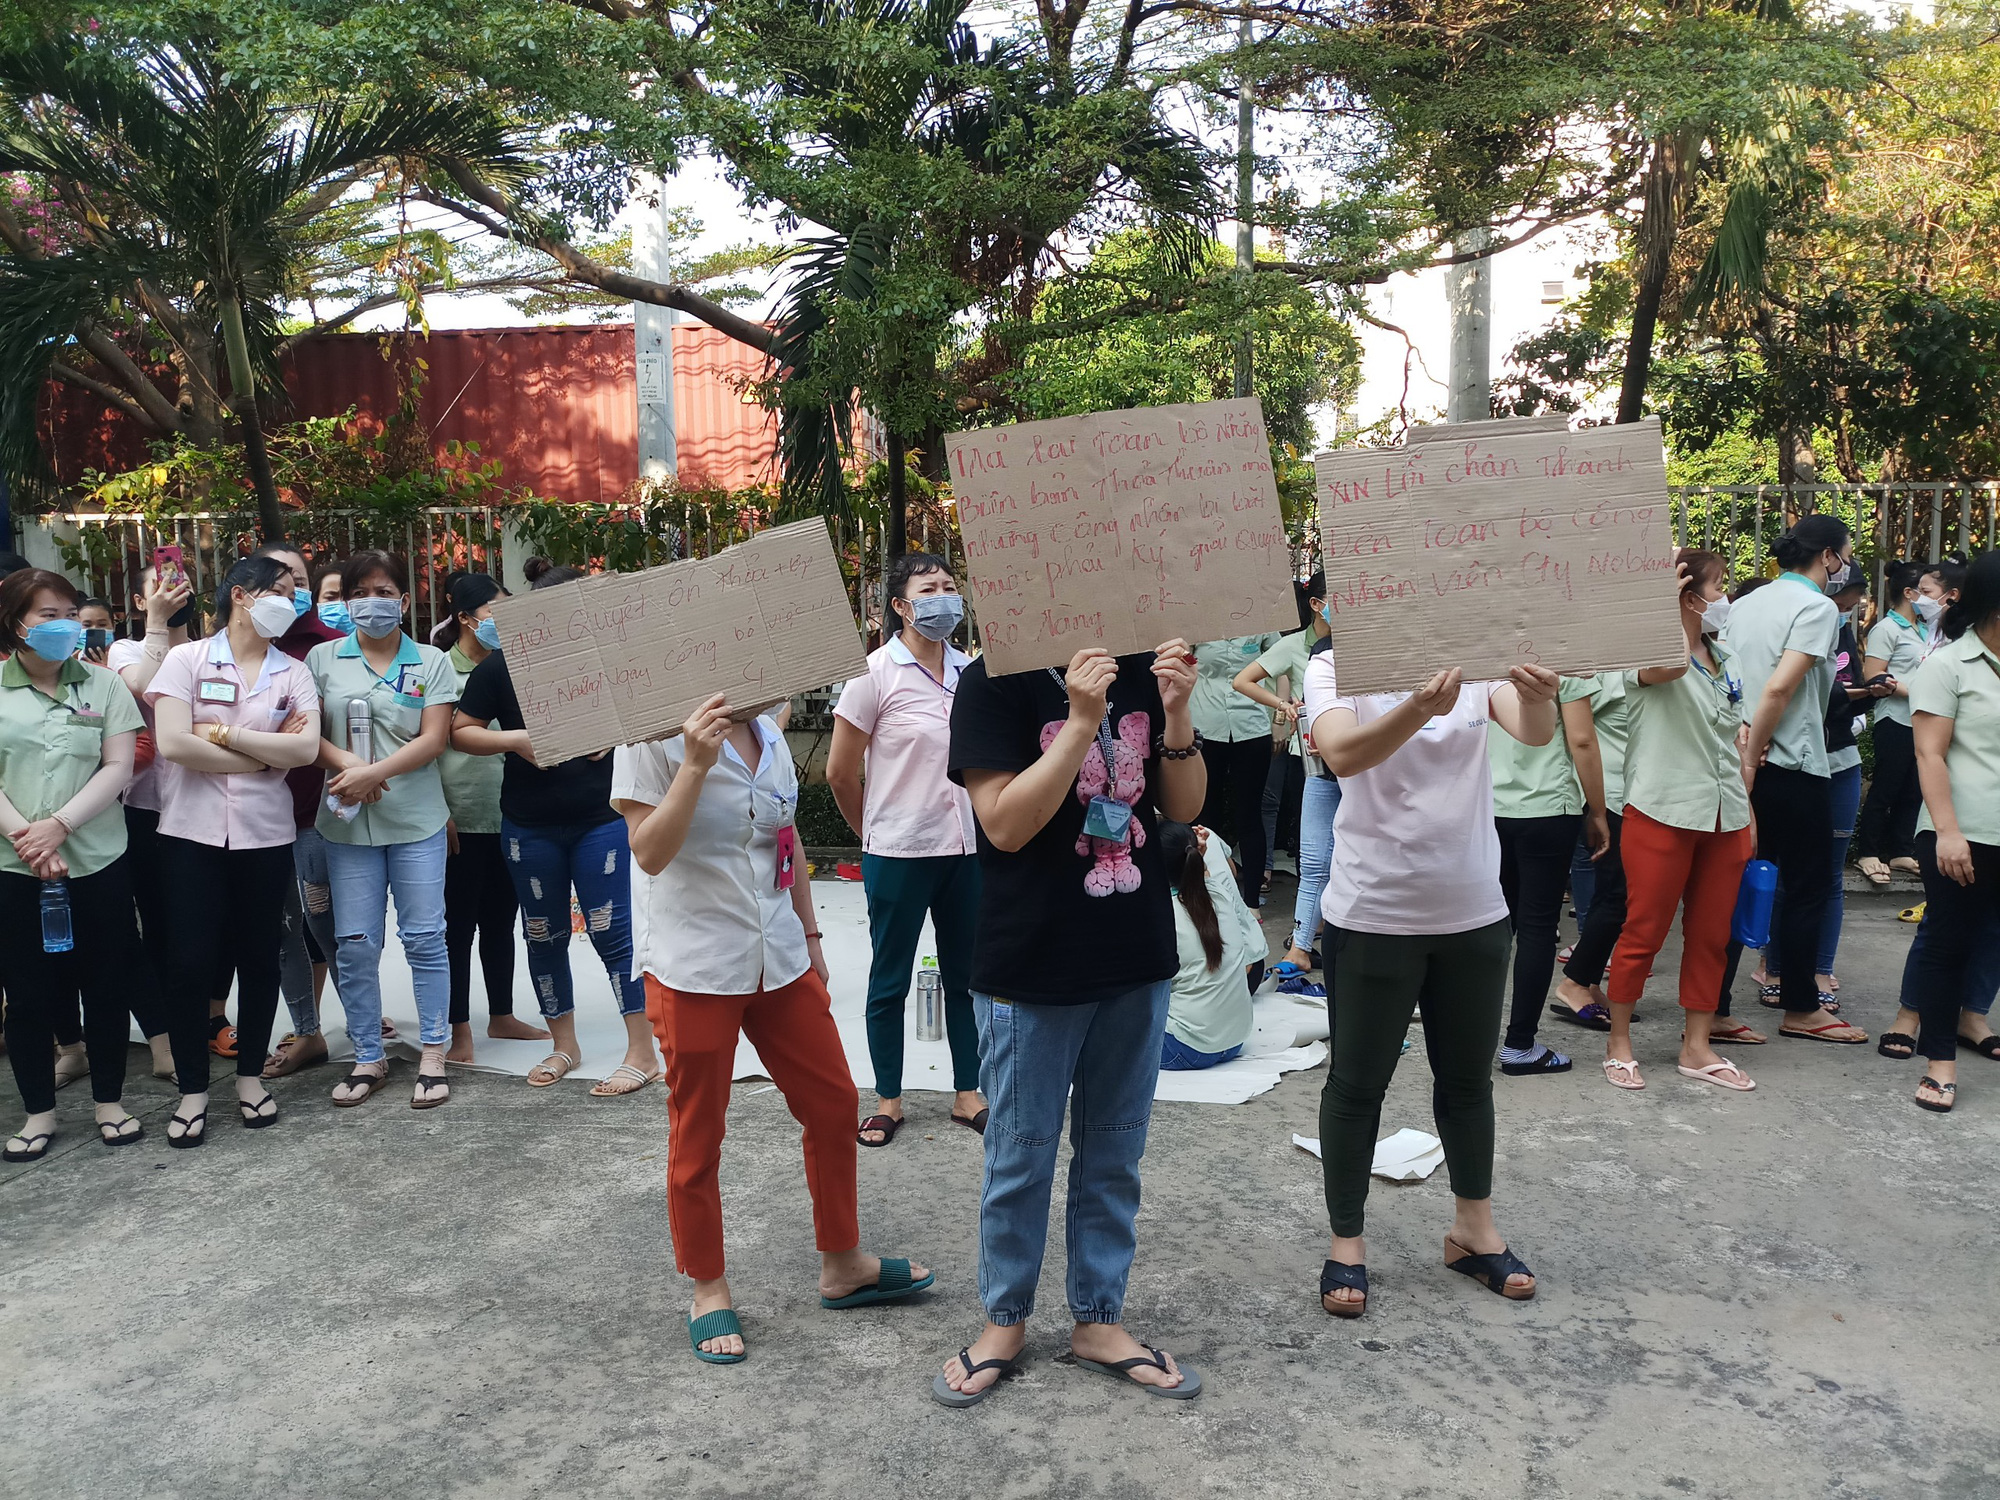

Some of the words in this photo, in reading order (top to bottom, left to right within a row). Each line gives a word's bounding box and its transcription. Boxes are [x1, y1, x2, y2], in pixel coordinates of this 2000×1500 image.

[1230, 597, 1253, 620] 2
[1517, 640, 1541, 664] 3
[1468, 718, 1488, 728] SEOUL
